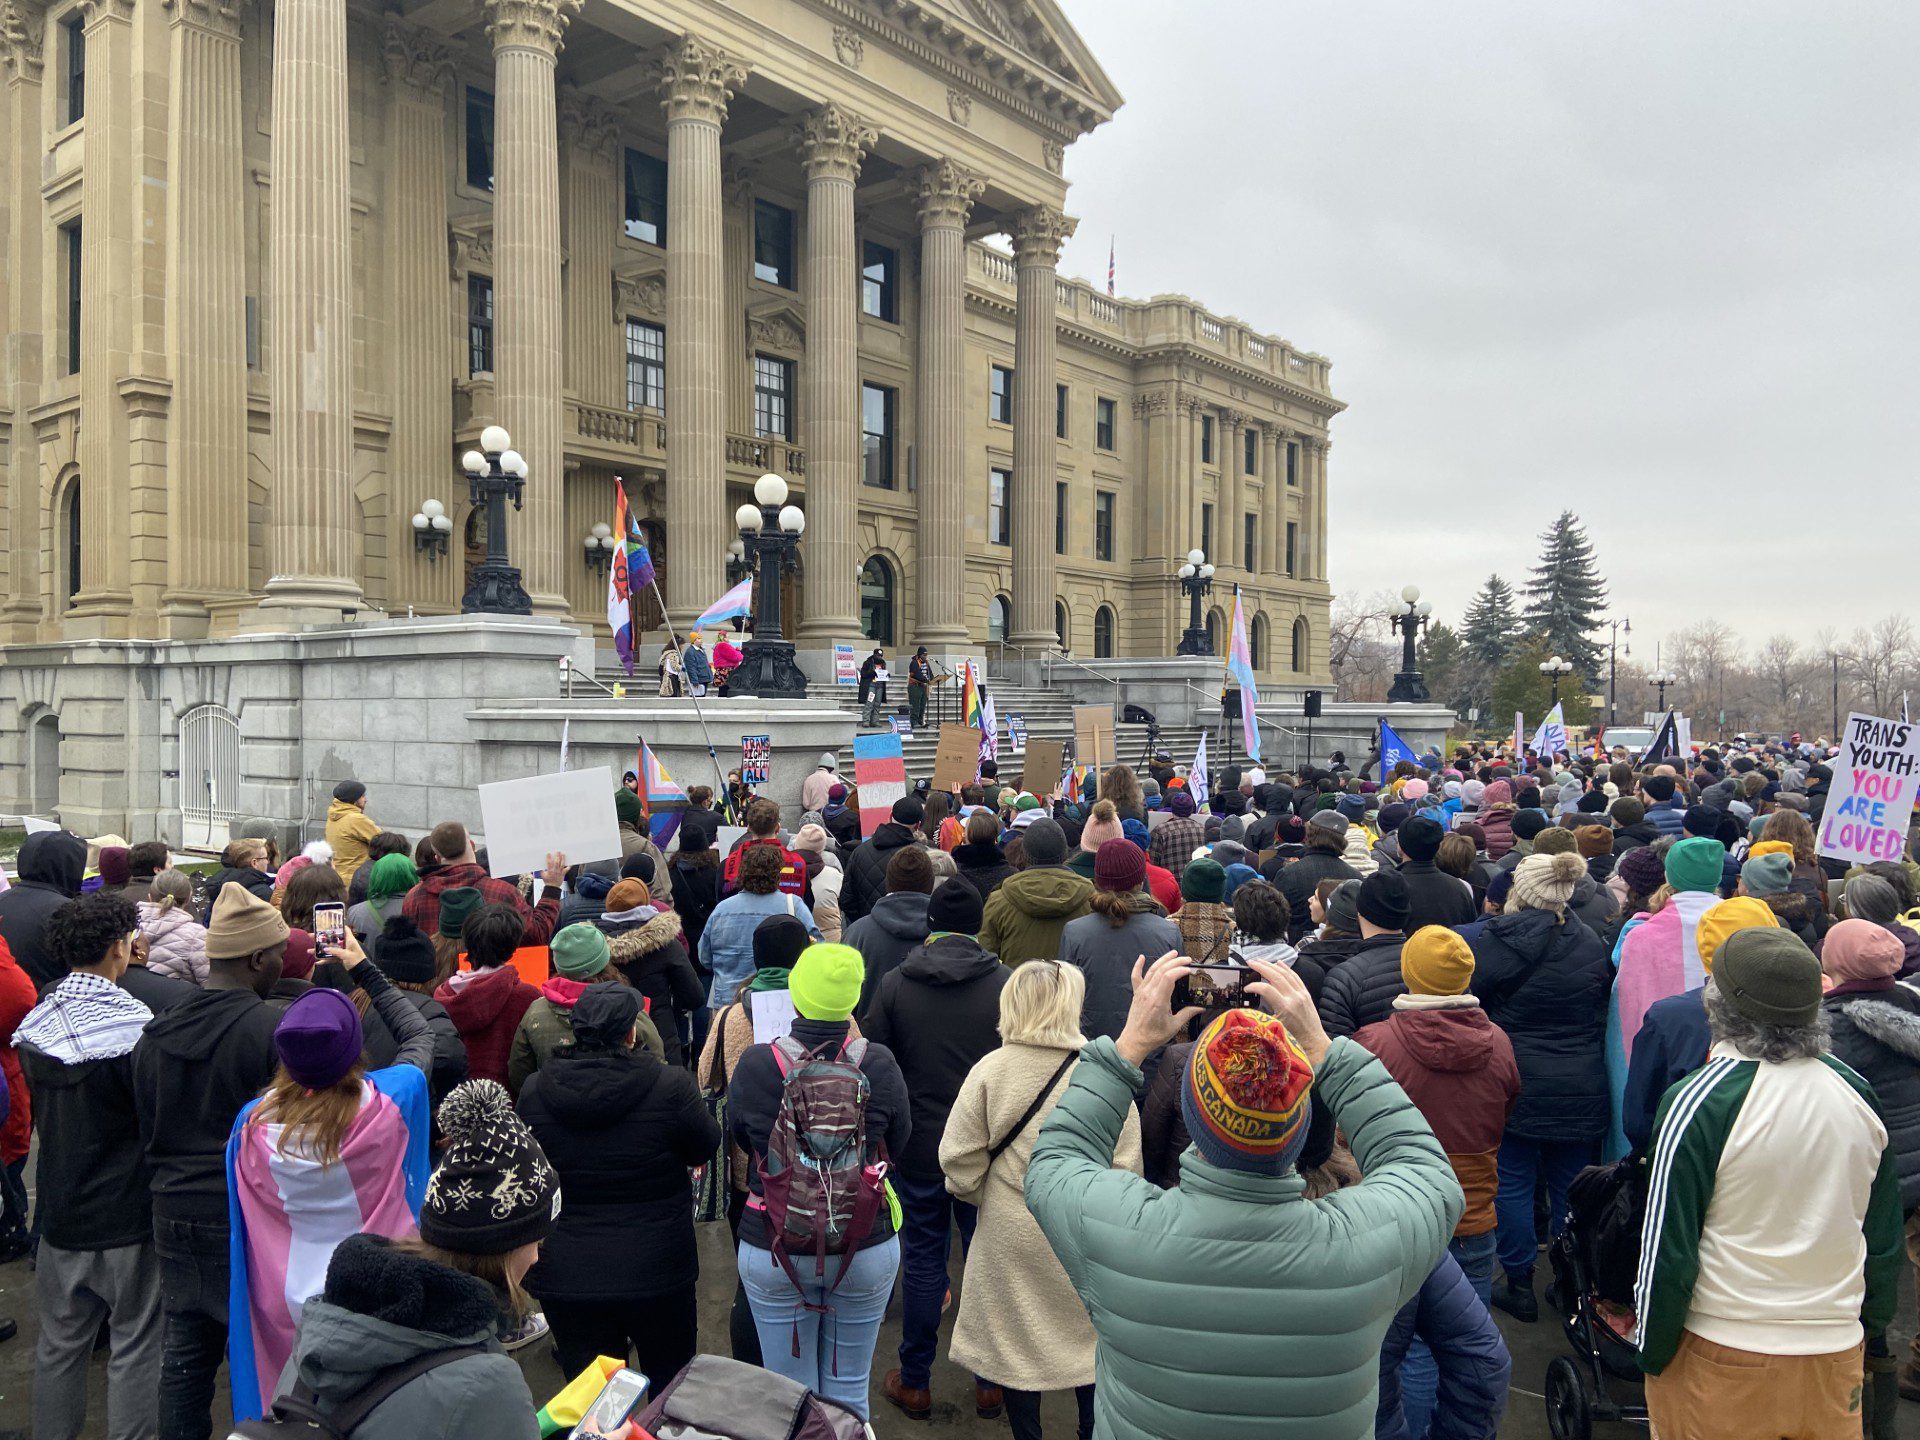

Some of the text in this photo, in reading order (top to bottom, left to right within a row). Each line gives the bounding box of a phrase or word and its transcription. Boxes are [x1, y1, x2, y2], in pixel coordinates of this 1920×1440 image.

[744, 737, 770, 749] TRANS
[1852, 718, 1912, 748] TRANS
[744, 749, 769, 759] RIGHTS
[744, 760, 769, 769] BENEFIT
[1850, 742, 1919, 776] YOUTH:
[746, 769, 765, 782] ALL
[1853, 769, 1903, 803] YOU
[1838, 796, 1885, 827] ARE
[1823, 816, 1903, 860] LOVED
[1203, 1087, 1271, 1137] CANADA
